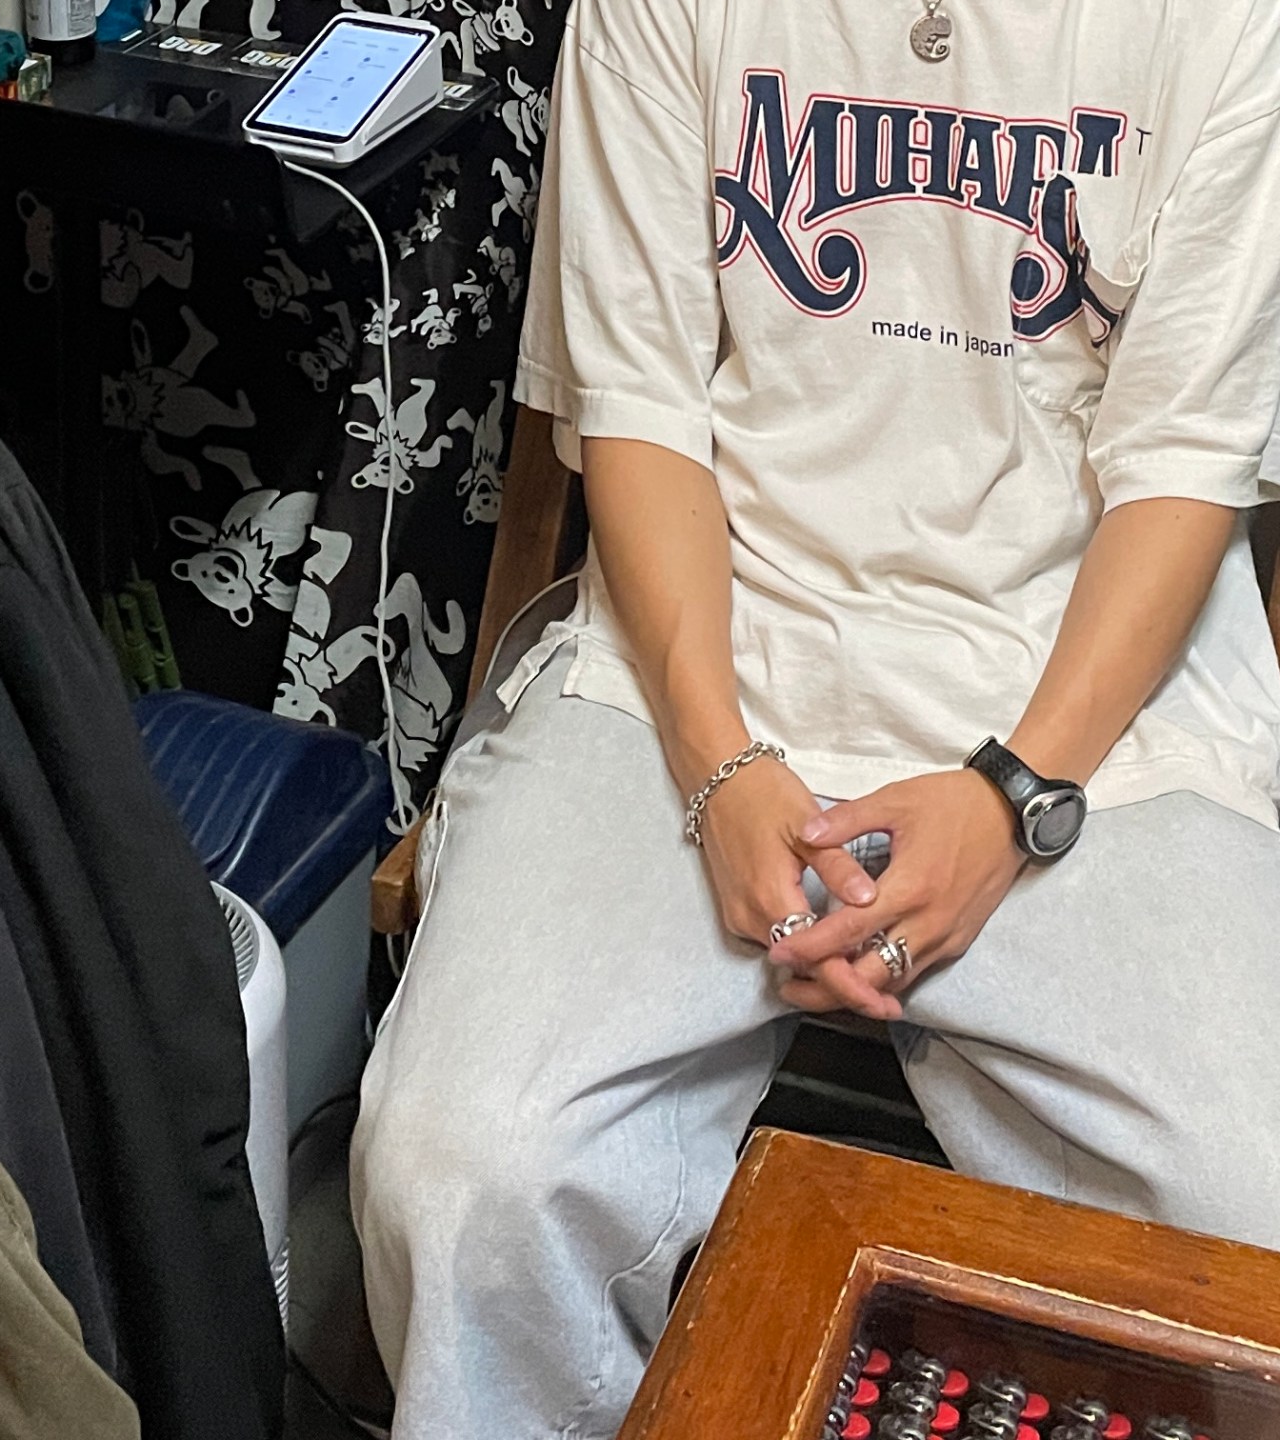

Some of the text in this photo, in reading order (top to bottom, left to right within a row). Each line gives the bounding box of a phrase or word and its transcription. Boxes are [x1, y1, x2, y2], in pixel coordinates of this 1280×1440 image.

[871, 321, 1015, 358] made in japan
